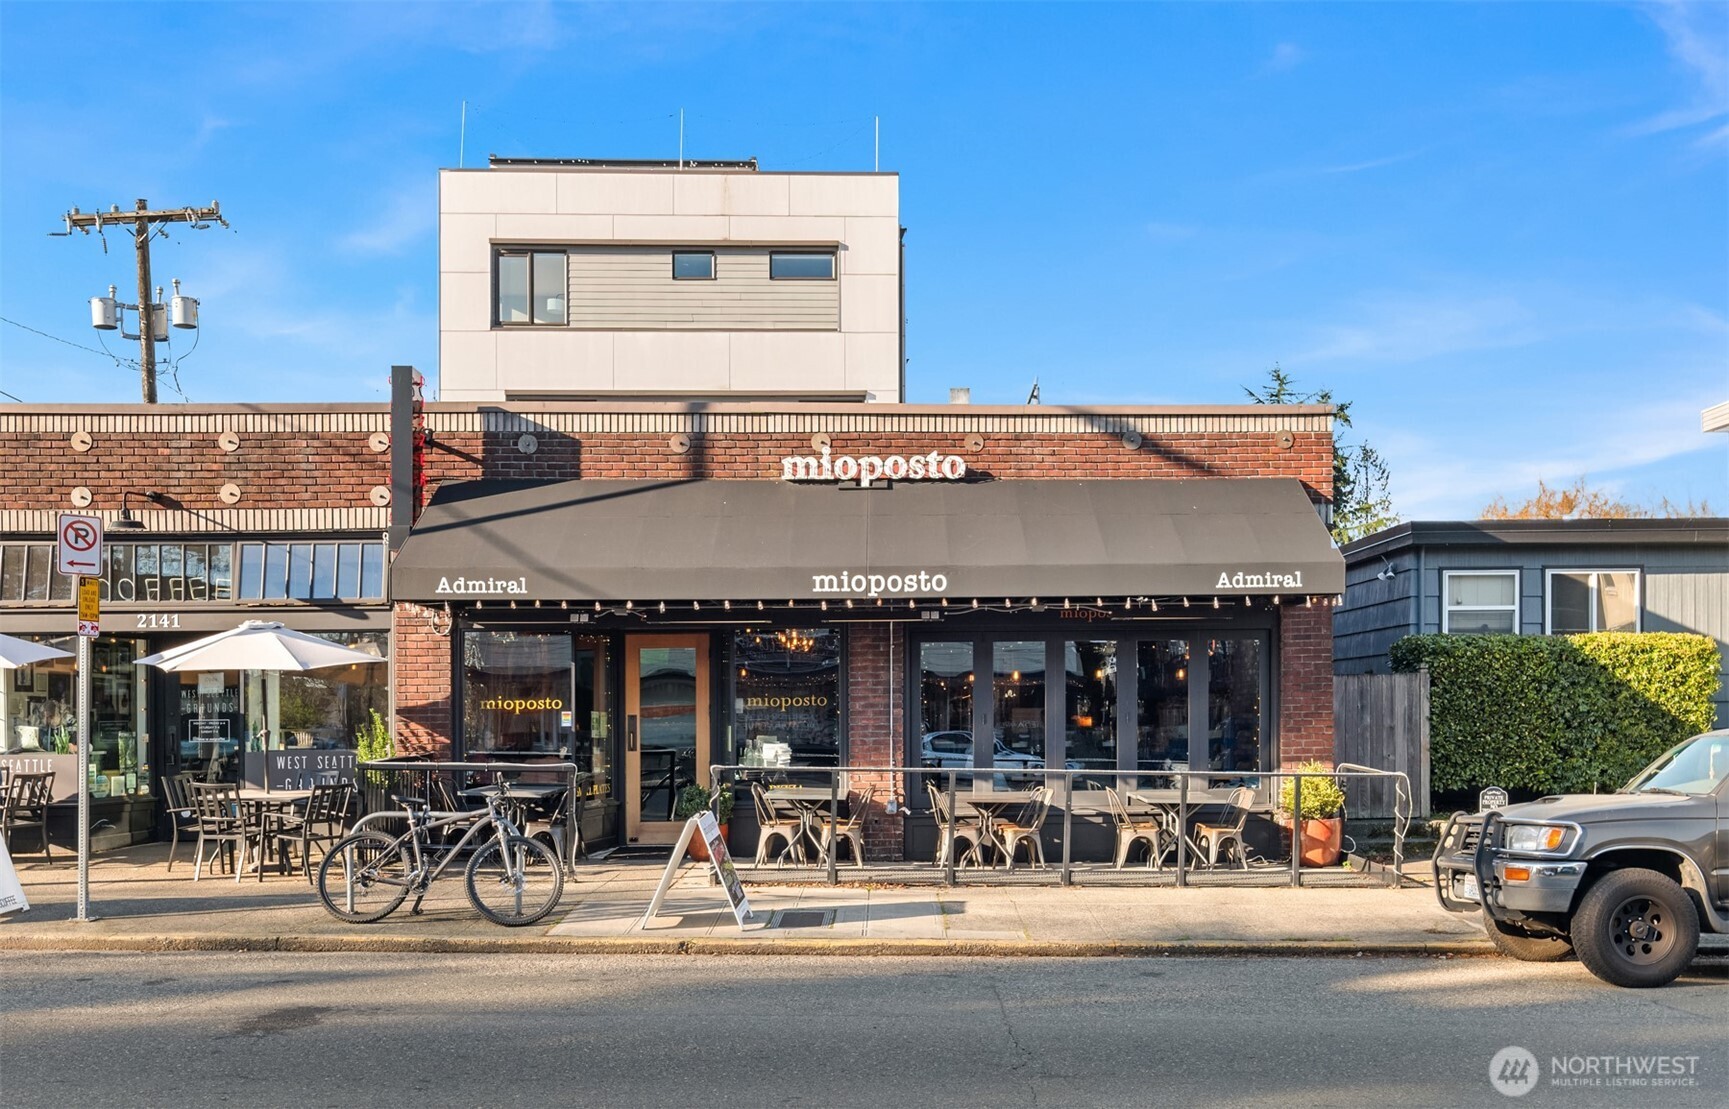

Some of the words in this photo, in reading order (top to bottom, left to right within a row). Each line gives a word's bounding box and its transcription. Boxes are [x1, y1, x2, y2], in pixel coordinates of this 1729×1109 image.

[781, 447, 966, 487] mioposto
[435, 576, 528, 594] Admiral
[812, 571, 948, 597] mioposto
[1215, 571, 1303, 589] Admiral
[136, 613, 181, 629] 2141
[480, 695, 563, 715] mioposto
[746, 693, 828, 712] mioposto
[277, 756, 307, 769] WEST
